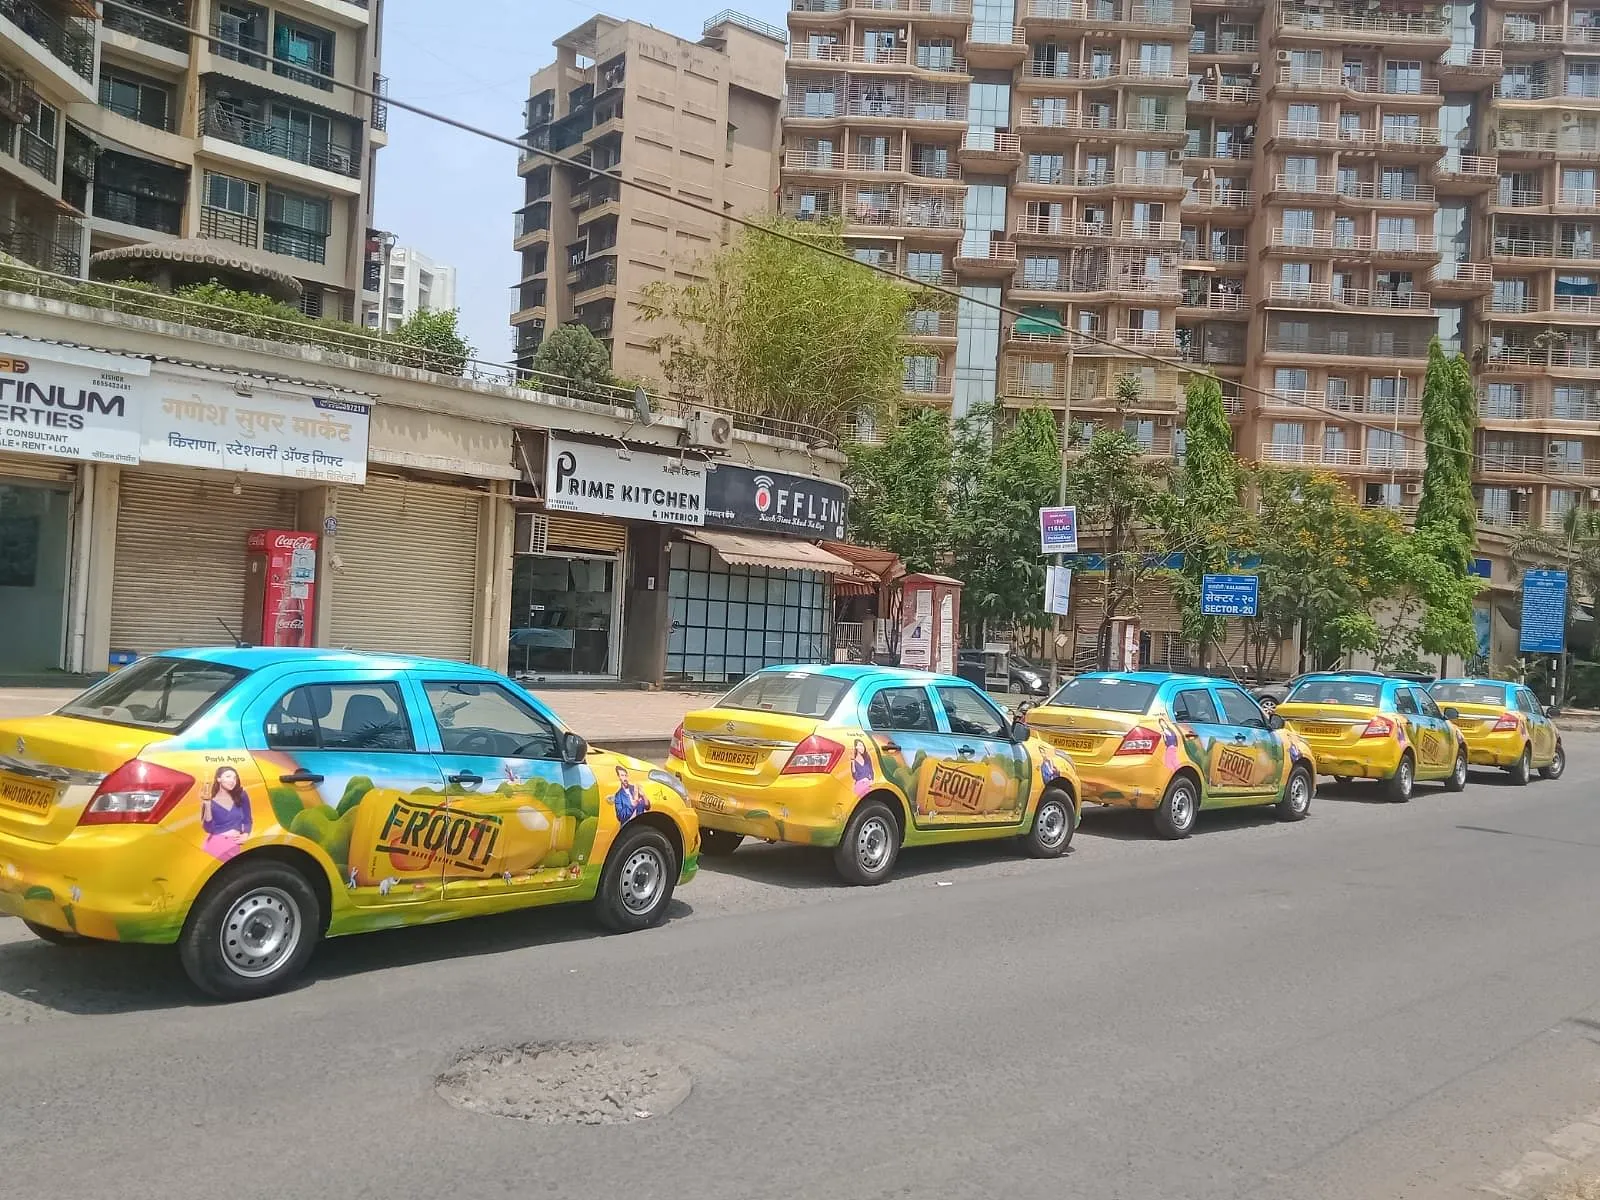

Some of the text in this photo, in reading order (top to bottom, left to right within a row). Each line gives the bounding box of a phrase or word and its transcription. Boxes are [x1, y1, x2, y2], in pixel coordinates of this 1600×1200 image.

[161, 393, 353, 442] गणेश सुपर मार्केट
[6, 428, 68, 443] CONSULTANT
[21, 441, 46, 451] RENT
[54, 445, 80, 455] LOAN
[225, 439, 278, 459] स्टेशनरी
[311, 449, 344, 468] गिफ्ट
[555, 450, 700, 511] PRIME KITCHEN
[660, 511, 699, 523] INTERIOR
[1205, 604, 1254, 615] SECTOR-20
[929, 765, 984, 807] FROOTI
[380, 802, 500, 866] FROOTI
